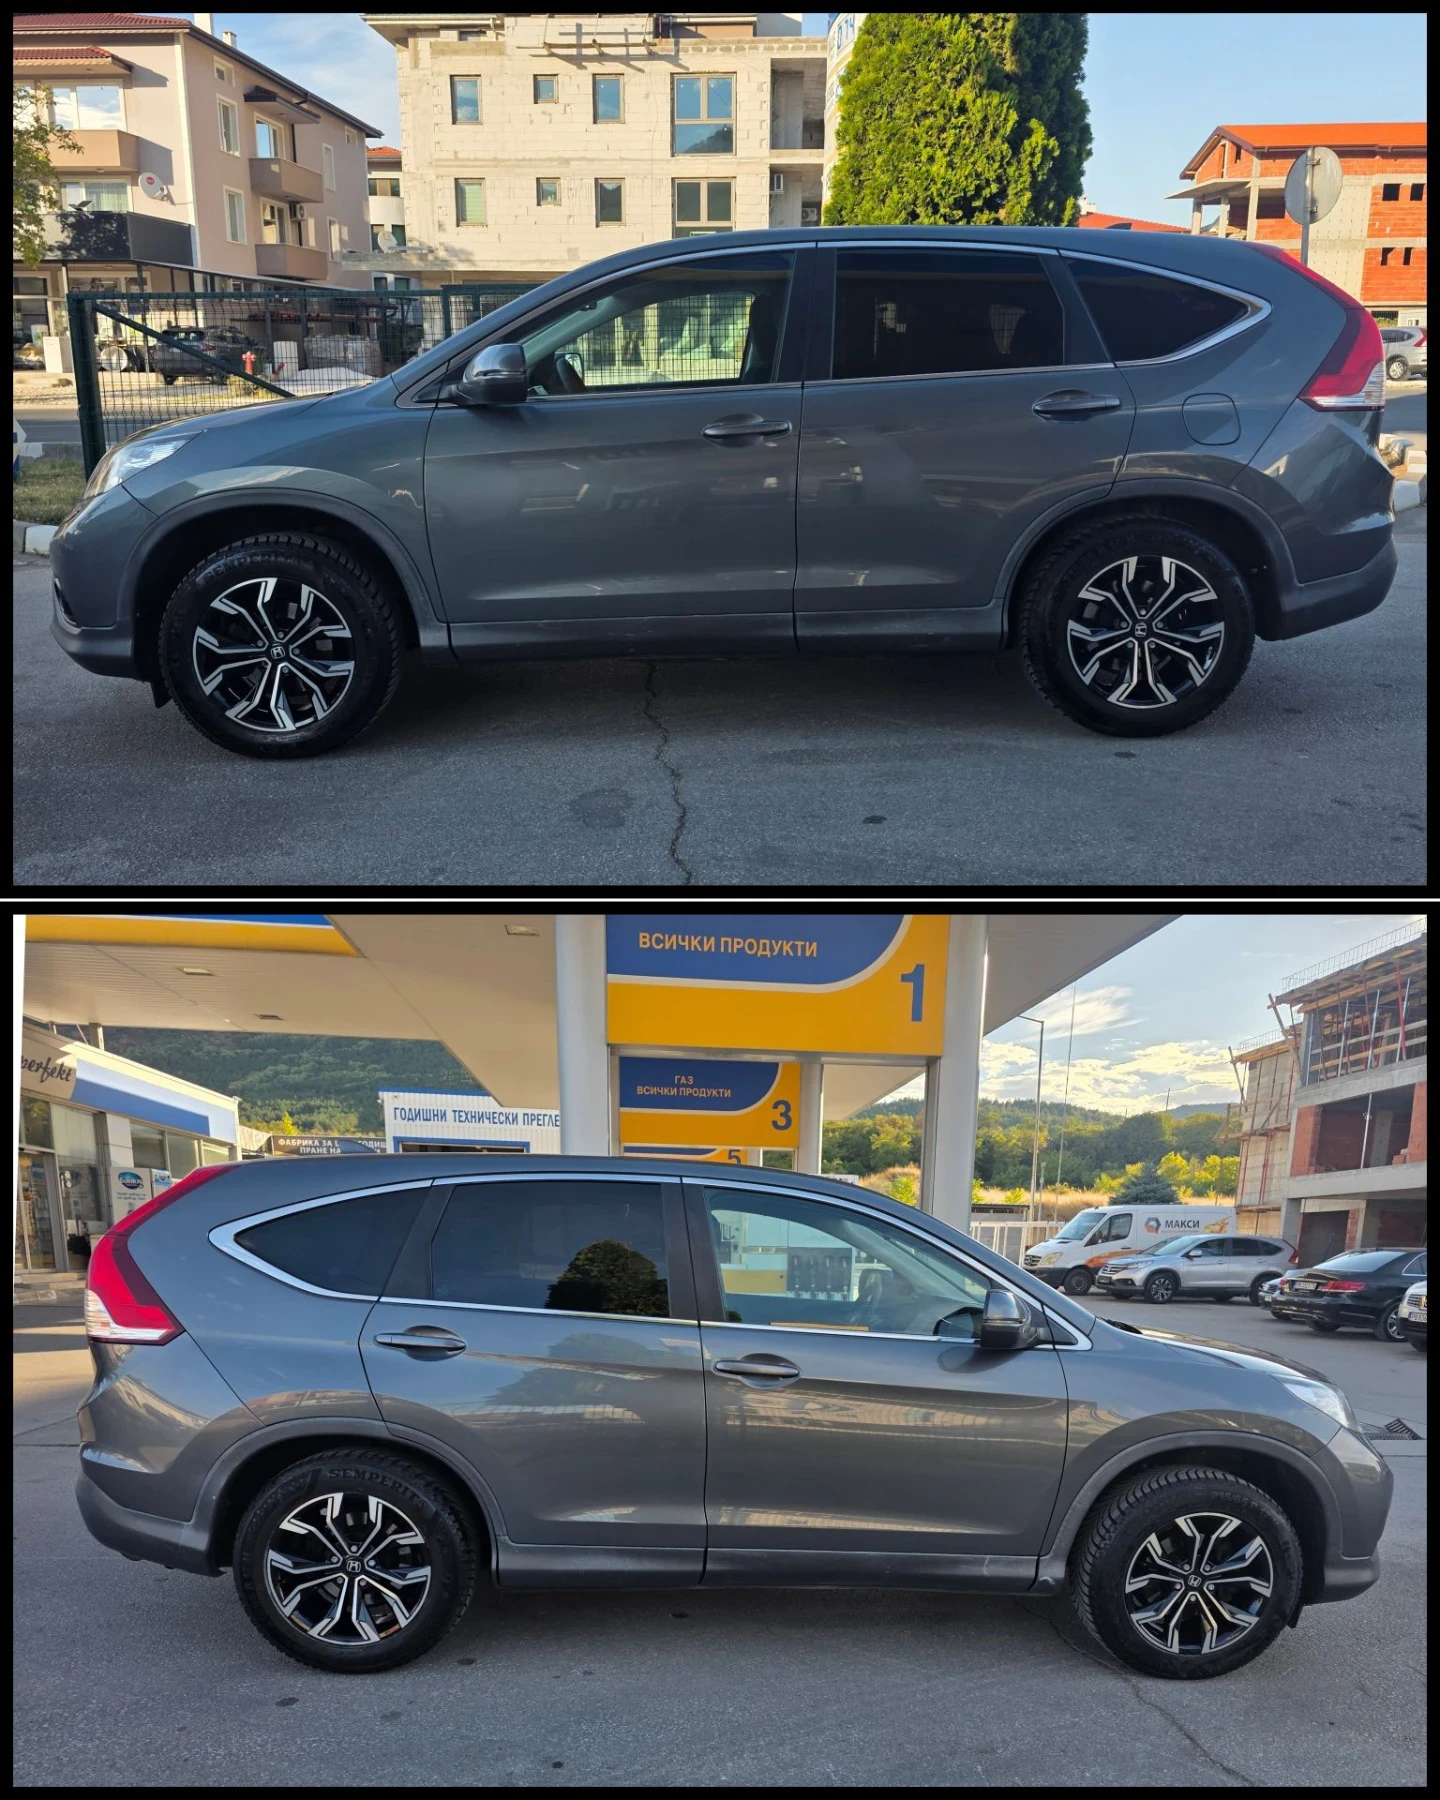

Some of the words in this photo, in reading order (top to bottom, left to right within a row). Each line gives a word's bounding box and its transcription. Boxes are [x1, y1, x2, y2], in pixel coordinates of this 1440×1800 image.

[638, 932, 715, 952] ВСИЧКИ
[720, 936, 818, 958] ПРОДУКТИ
[900, 963, 925, 1022] 1
[674, 1075, 694, 1085] ГАЗ
[636, 1086, 677, 1096] ВСИЧКИ
[679, 1087, 732, 1098] ПРОДУКТИ
[393, 1107, 447, 1122] ГОДИШНИ
[452, 1109, 518, 1126] ТЕХНИЧЕСКИ
[771, 1099, 793, 1131] 3
[278, 1138, 319, 1147] ФАБРИКА
[321, 1139, 333, 1147] ЗА
[300, 1146, 328, 1154] ПРАНЕ
[1164, 1219, 1200, 1229] МАКСИ
